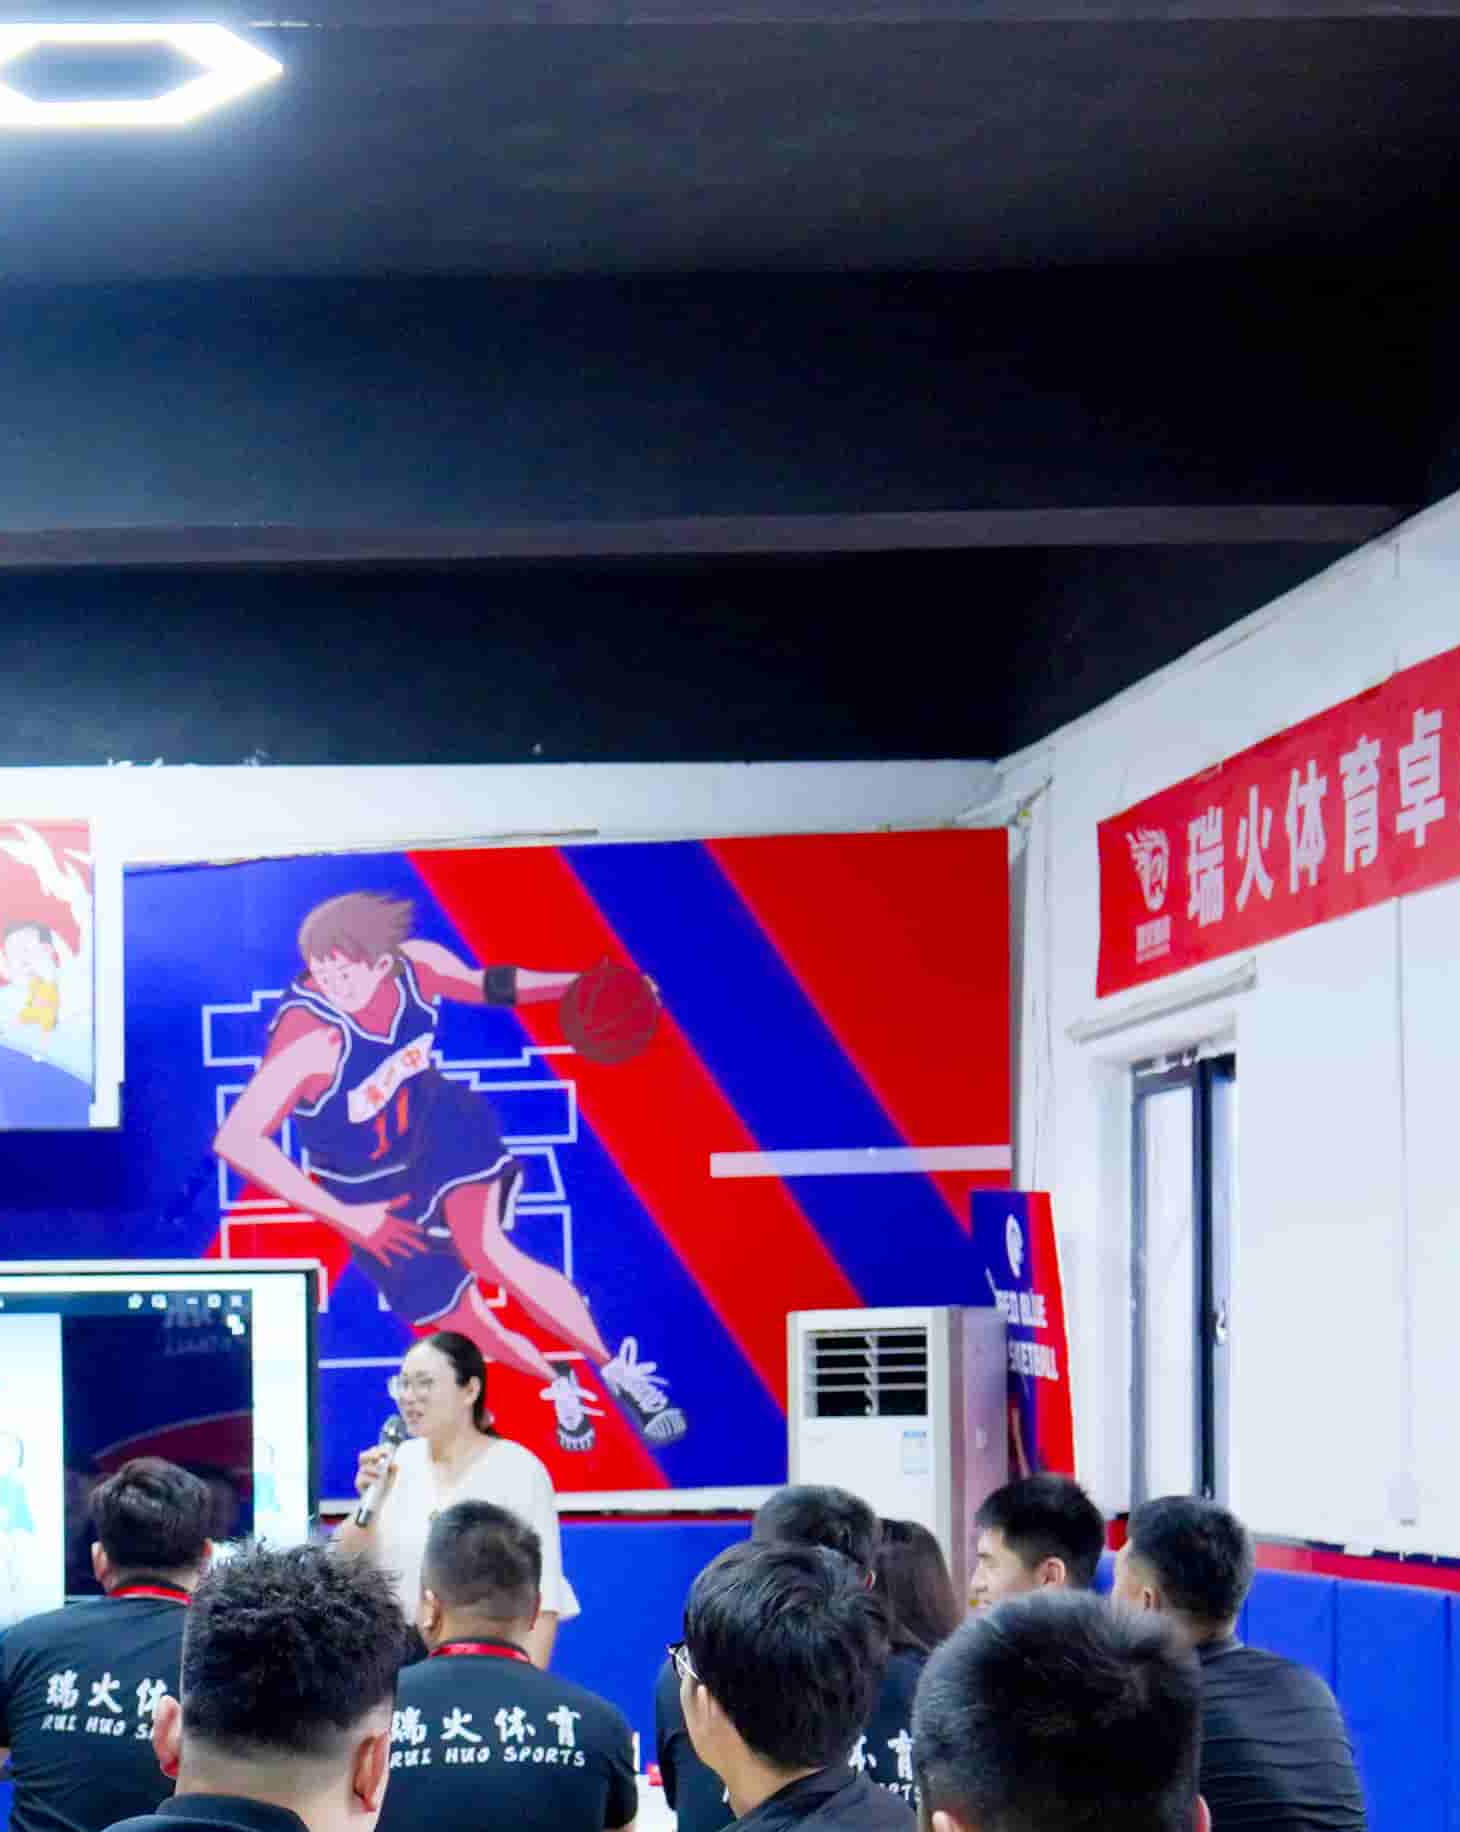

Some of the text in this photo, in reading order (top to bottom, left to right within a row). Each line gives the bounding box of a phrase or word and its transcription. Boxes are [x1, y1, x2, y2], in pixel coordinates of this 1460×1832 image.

[46, 1669, 170, 1717] 瑞火体
[85, 1716, 126, 1737] HUO
[391, 1705, 581, 1747] 瑞火体育
[389, 1746, 585, 1768] RUI HUO SPORTS
